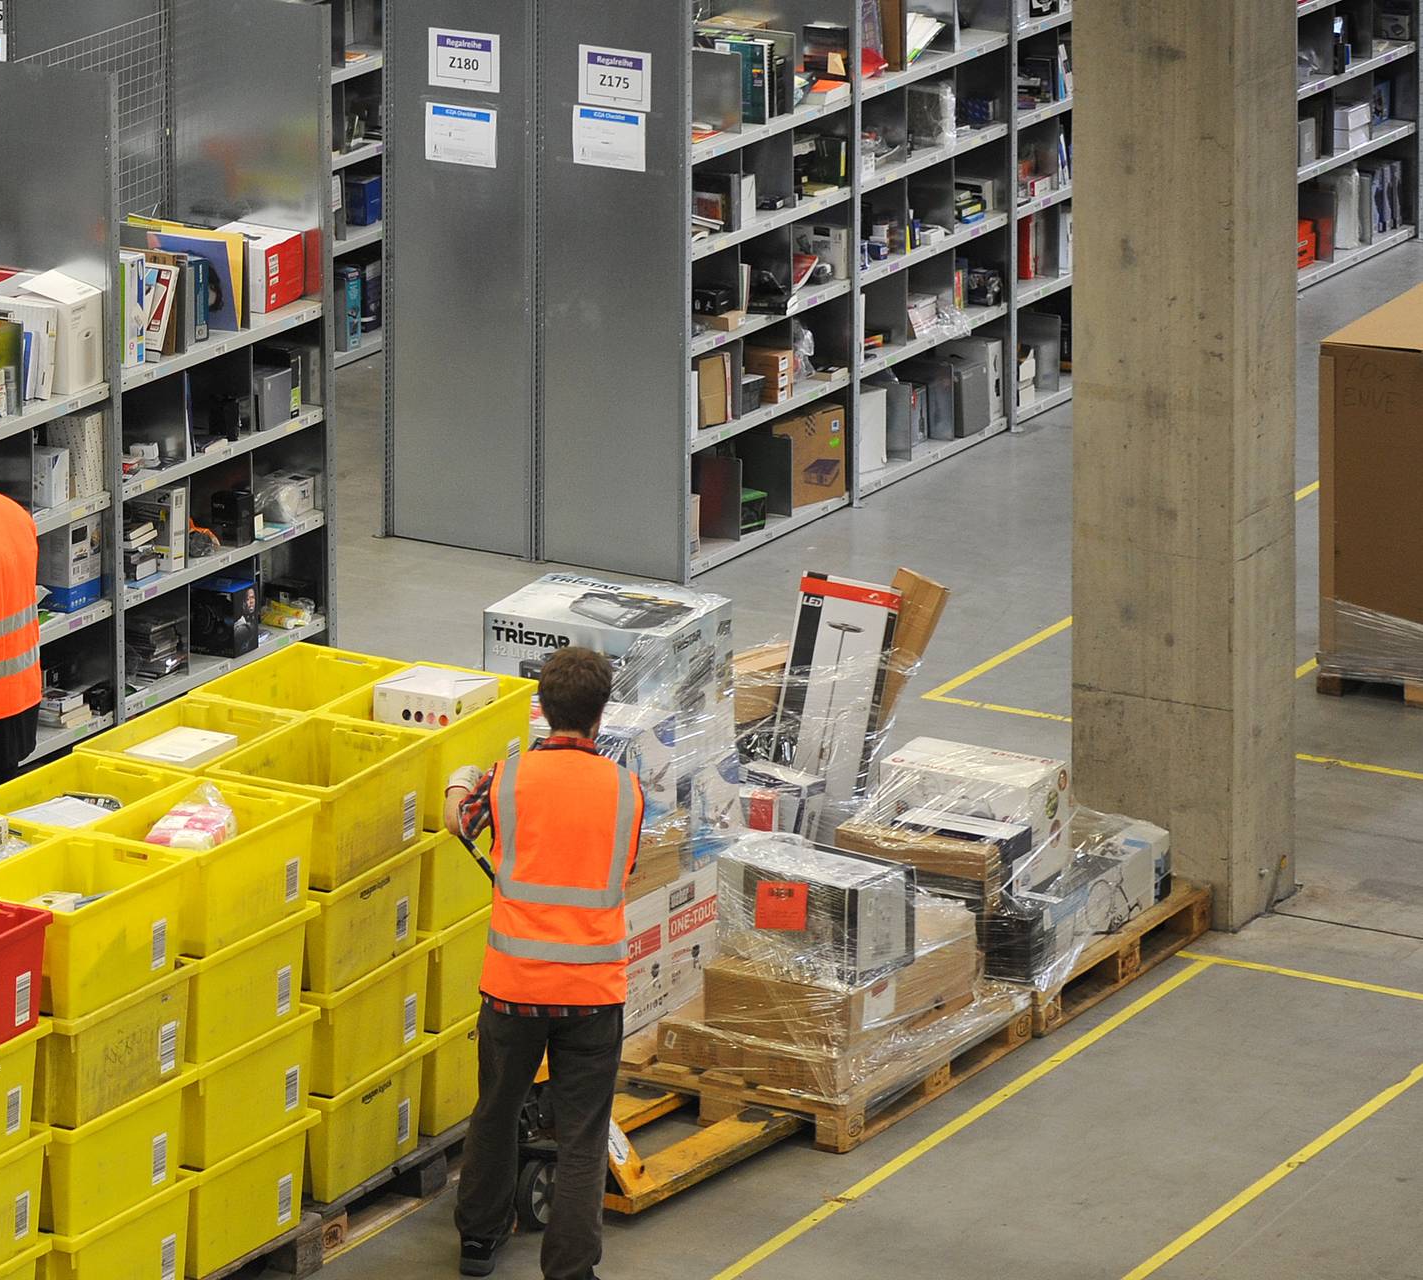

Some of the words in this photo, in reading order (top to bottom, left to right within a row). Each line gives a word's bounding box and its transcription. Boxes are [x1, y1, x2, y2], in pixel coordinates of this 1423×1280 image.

[446, 37, 482, 50] Regalreihe
[448, 56, 479, 71] Z180
[596, 55, 634, 68] Regalreihe
[599, 74, 630, 89] Z175
[802, 594, 823, 608] LED
[492, 644, 507, 656] 42
[670, 900, 718, 937] ONE-TOUC
